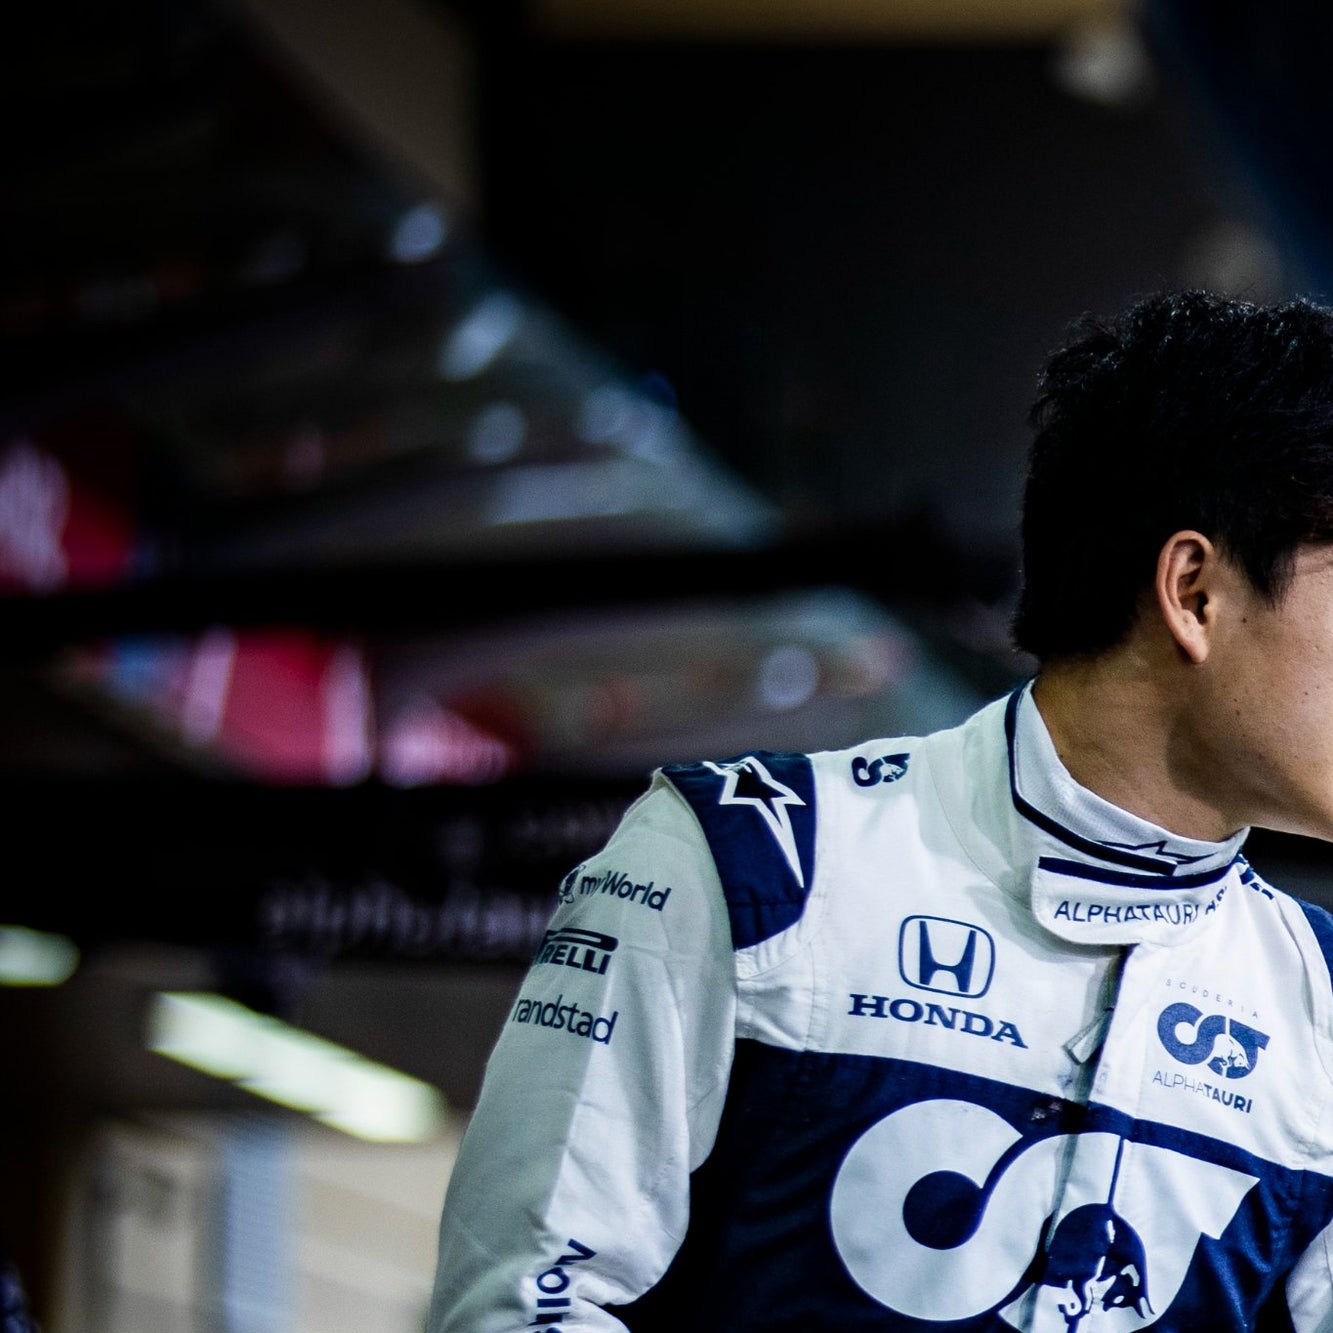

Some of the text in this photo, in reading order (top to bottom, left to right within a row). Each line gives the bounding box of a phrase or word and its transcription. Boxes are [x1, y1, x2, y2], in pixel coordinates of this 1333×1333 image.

[535, 927, 619, 976] PRELLI
[512, 993, 619, 1046] randstad
[847, 993, 1029, 1049] HONDA
[1165, 978, 1259, 1019] SCUDERIA
[1152, 1069, 1253, 1114] ALPHATAURI
